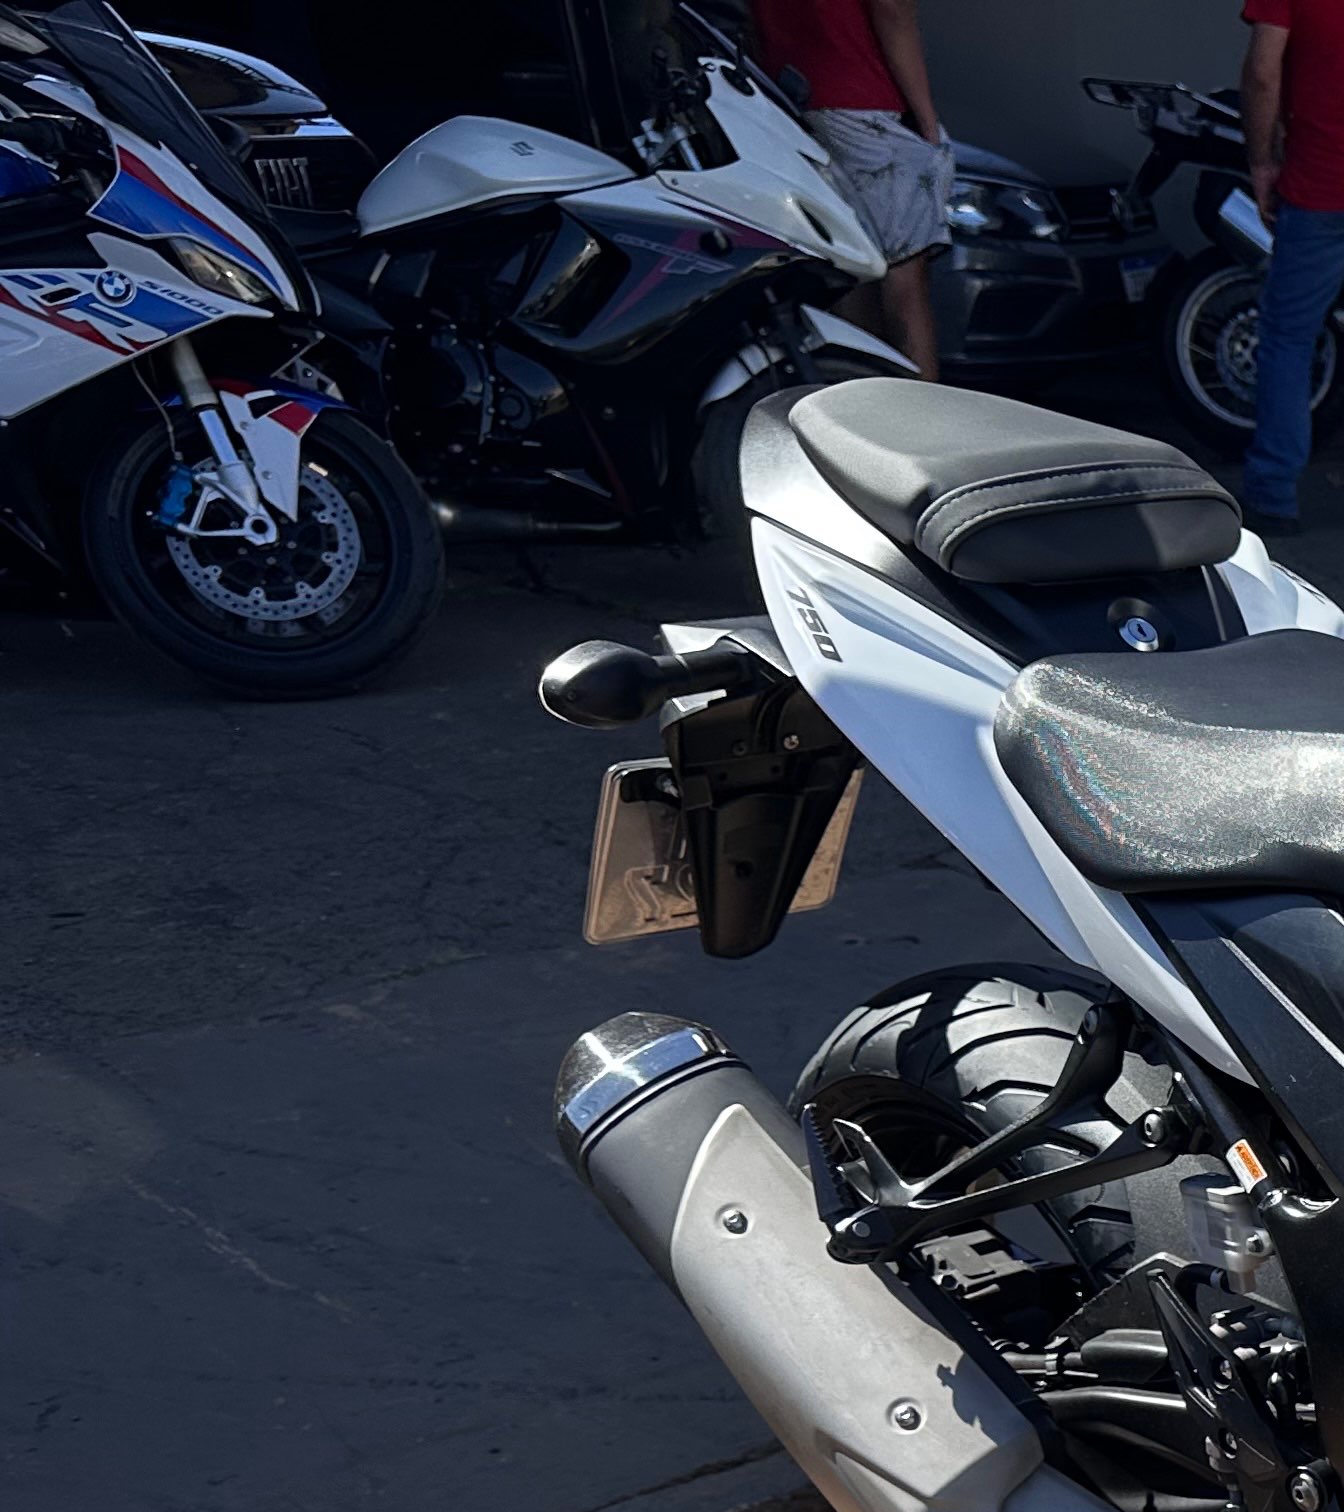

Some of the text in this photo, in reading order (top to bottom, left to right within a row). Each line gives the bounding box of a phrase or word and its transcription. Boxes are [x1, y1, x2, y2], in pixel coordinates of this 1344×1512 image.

[254, 156, 314, 208] FIAT
[138, 280, 224, 314] S1000
[786, 587, 843, 662] 750
